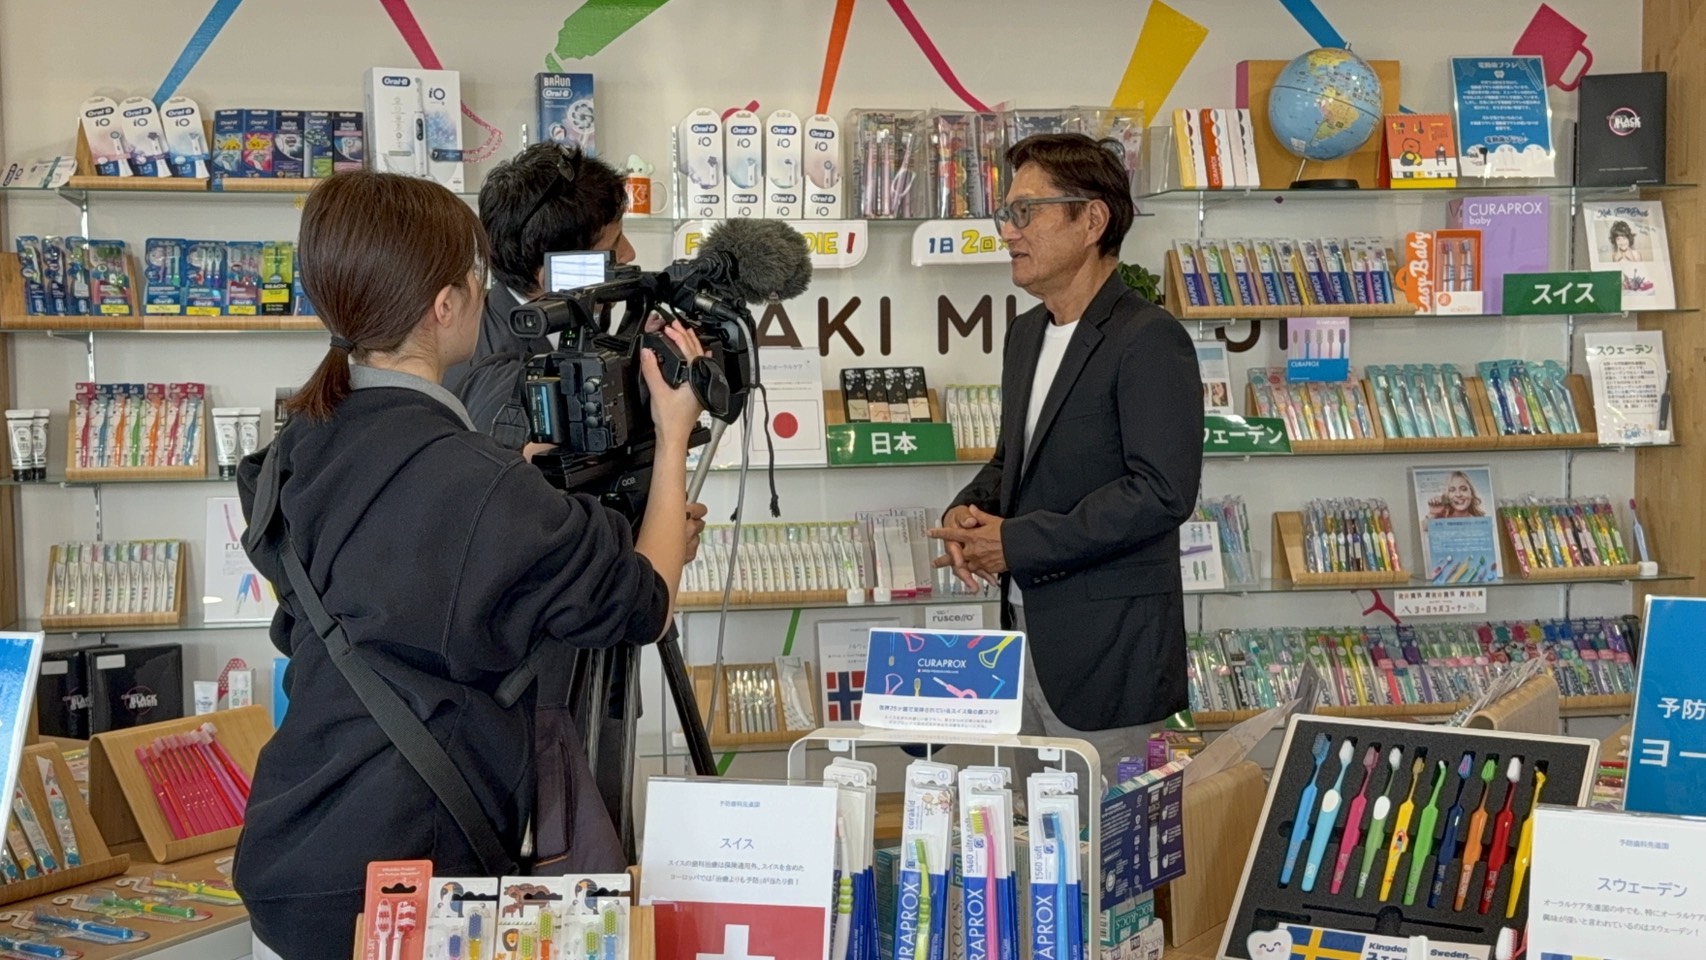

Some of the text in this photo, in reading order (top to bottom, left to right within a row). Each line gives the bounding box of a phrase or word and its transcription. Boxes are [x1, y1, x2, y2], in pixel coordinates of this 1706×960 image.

[544, 75, 571, 87] BRAUN
[773, 126, 796, 134] Oral-B
[811, 130, 833, 138] Oral-B
[694, 195, 718, 203] Oral-B
[733, 195, 756, 203] Oral-B
[772, 195, 795, 203] Oral-B
[811, 195, 834, 203] Oral-B
[1469, 202, 1543, 216] CURAPROX
[1469, 216, 1491, 227] baby
[1532, 282, 1595, 305] スイス
[757, 296, 892, 356] AKI
[1597, 345, 1653, 356] スウェーデン
[1204, 424, 1283, 445] ェーデン
[870, 431, 918, 456] 日本
[932, 613, 975, 622] ruscello
[917, 657, 967, 669] CURAPROX
[1657, 698, 1706, 719] 予防
[907, 800, 916, 830] curakid
[720, 837, 755, 850] スイス
[965, 834, 974, 852] ultra
[1619, 838, 1670, 850] 予防歯科先進国
[966, 854, 975, 873] 5460
[1033, 845, 1043, 880] 1560 soft
[1597, 876, 1688, 898] スウェーデン
[898, 882, 920, 960] RAPROX
[1035, 895, 1054, 960] APROX
[1430, 948, 1470, 959] Sweden
